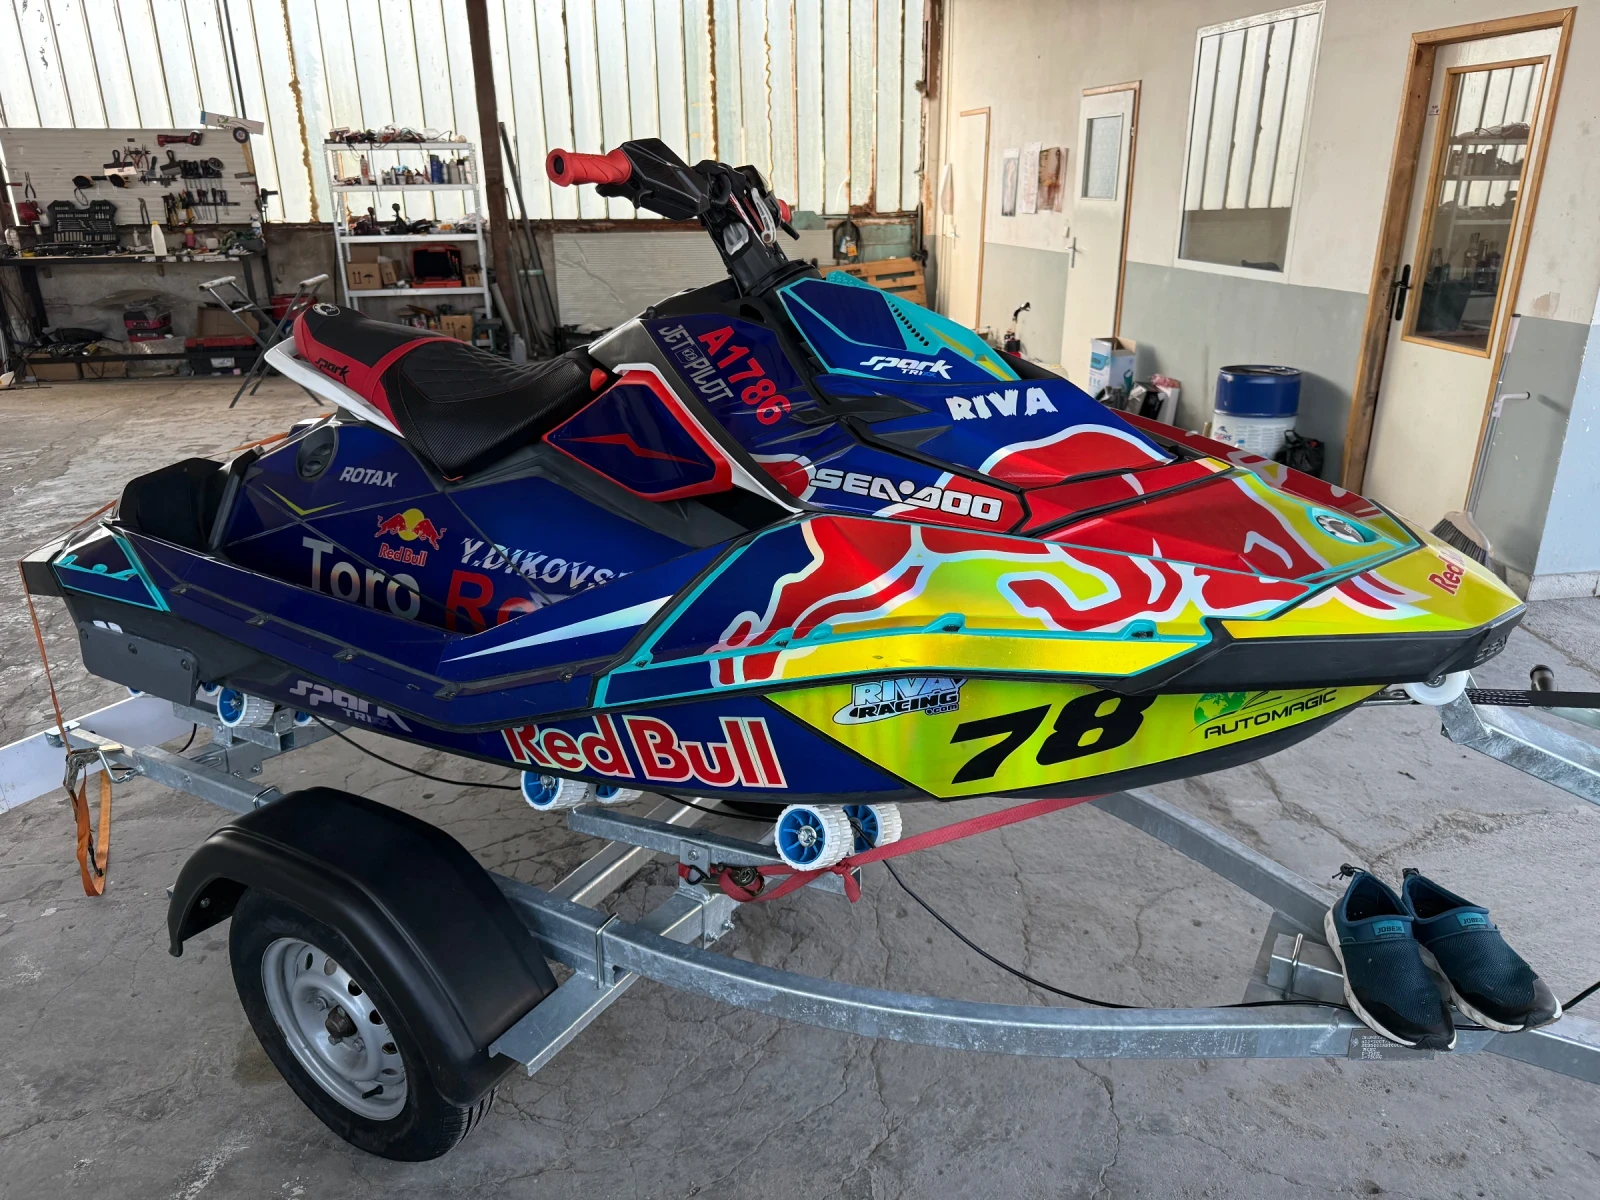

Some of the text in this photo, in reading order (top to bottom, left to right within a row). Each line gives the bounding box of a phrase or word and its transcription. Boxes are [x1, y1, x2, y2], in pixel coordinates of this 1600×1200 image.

[315, 358, 350, 383] spark
[697, 325, 791, 426] A1786
[859, 355, 953, 380] spark
[945, 386, 1058, 421] RIVA
[338, 466, 398, 488] ROTAX
[378, 542, 428, 567] Red Bull
[460, 537, 634, 592] Y.DIKOVS
[302, 536, 421, 621] Toro
[849, 690, 959, 718] RACING
[853, 677, 957, 707] RIVA
[1204, 689, 1337, 740] AUTOMAGIC
[501, 714, 789, 789] Red Bull
[950, 689, 1158, 784] 78
